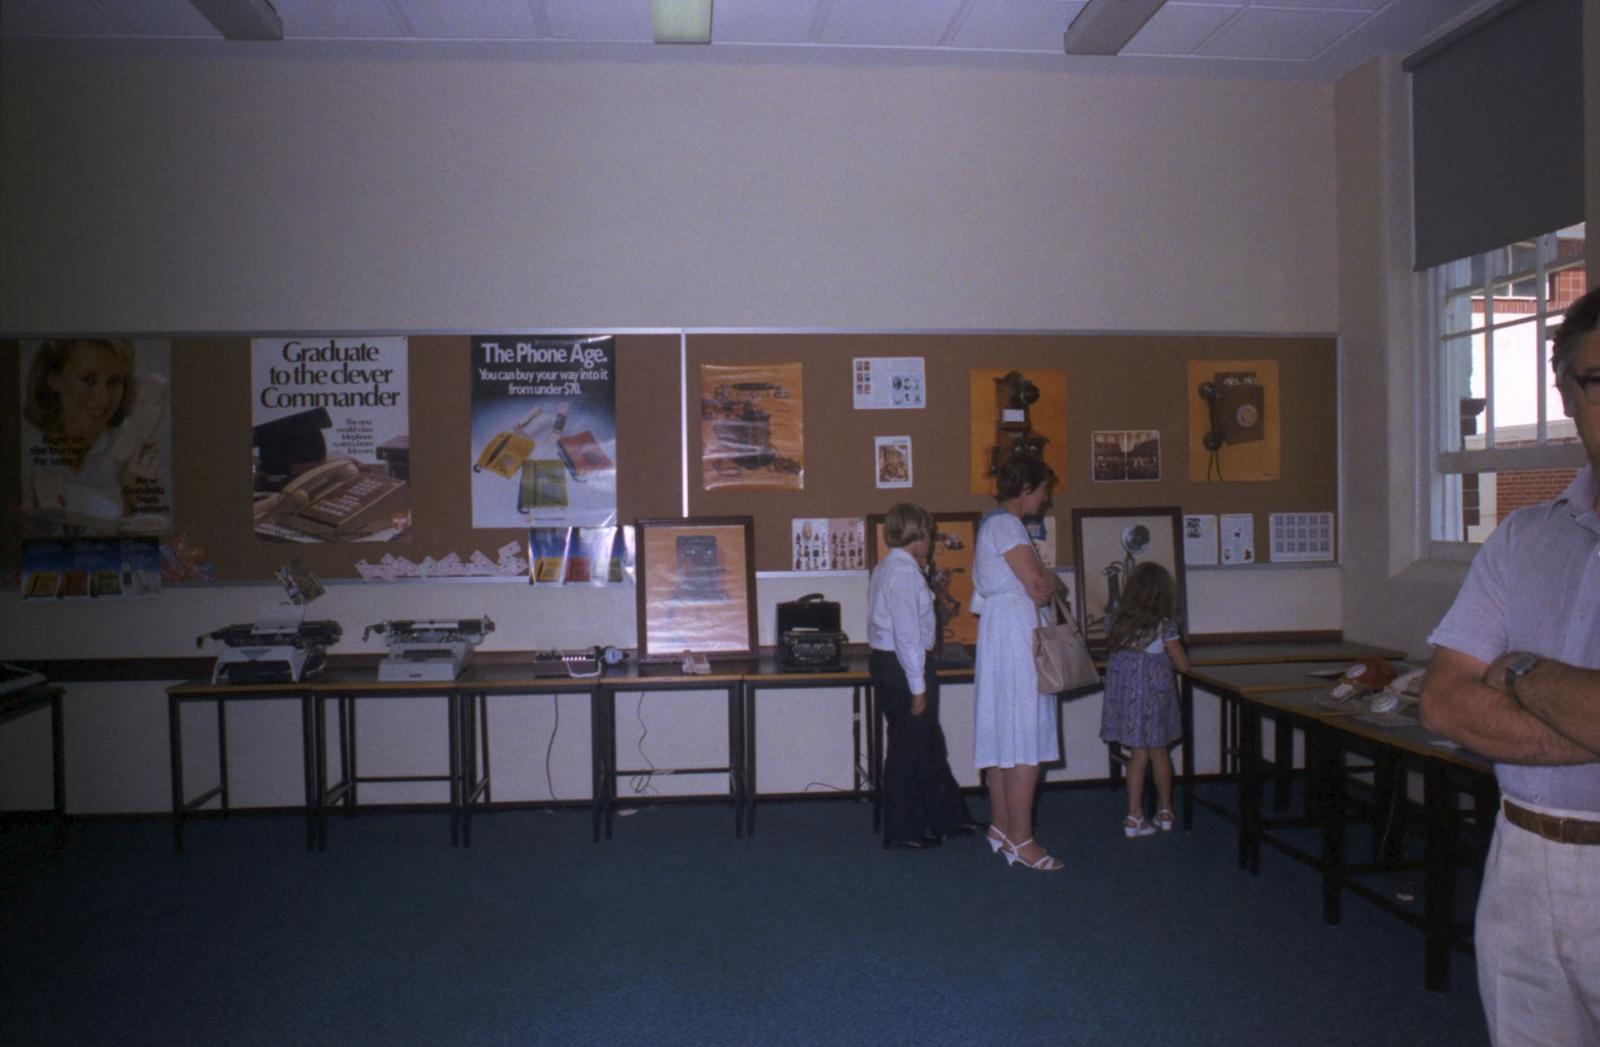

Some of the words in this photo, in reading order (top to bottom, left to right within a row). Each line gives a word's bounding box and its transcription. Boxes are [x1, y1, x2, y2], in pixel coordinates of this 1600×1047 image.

[282, 340, 379, 363] Graduate
[481, 343, 514, 363] The
[516, 343, 567, 363] Phone
[570, 343, 608, 369] Age.
[270, 367, 291, 385] to
[294, 362, 328, 385] the
[331, 362, 393, 385] clever
[479, 368, 498, 381] You
[498, 371, 516, 381] can
[516, 368, 534, 383] buy
[536, 371, 559, 383] your
[560, 371, 580, 383] way
[580, 368, 599, 380] into
[600, 368, 608, 380] it
[260, 384, 400, 409] Commander
[508, 382, 535, 395] from
[535, 382, 563, 395] under
[136, 495, 159, 504] from
